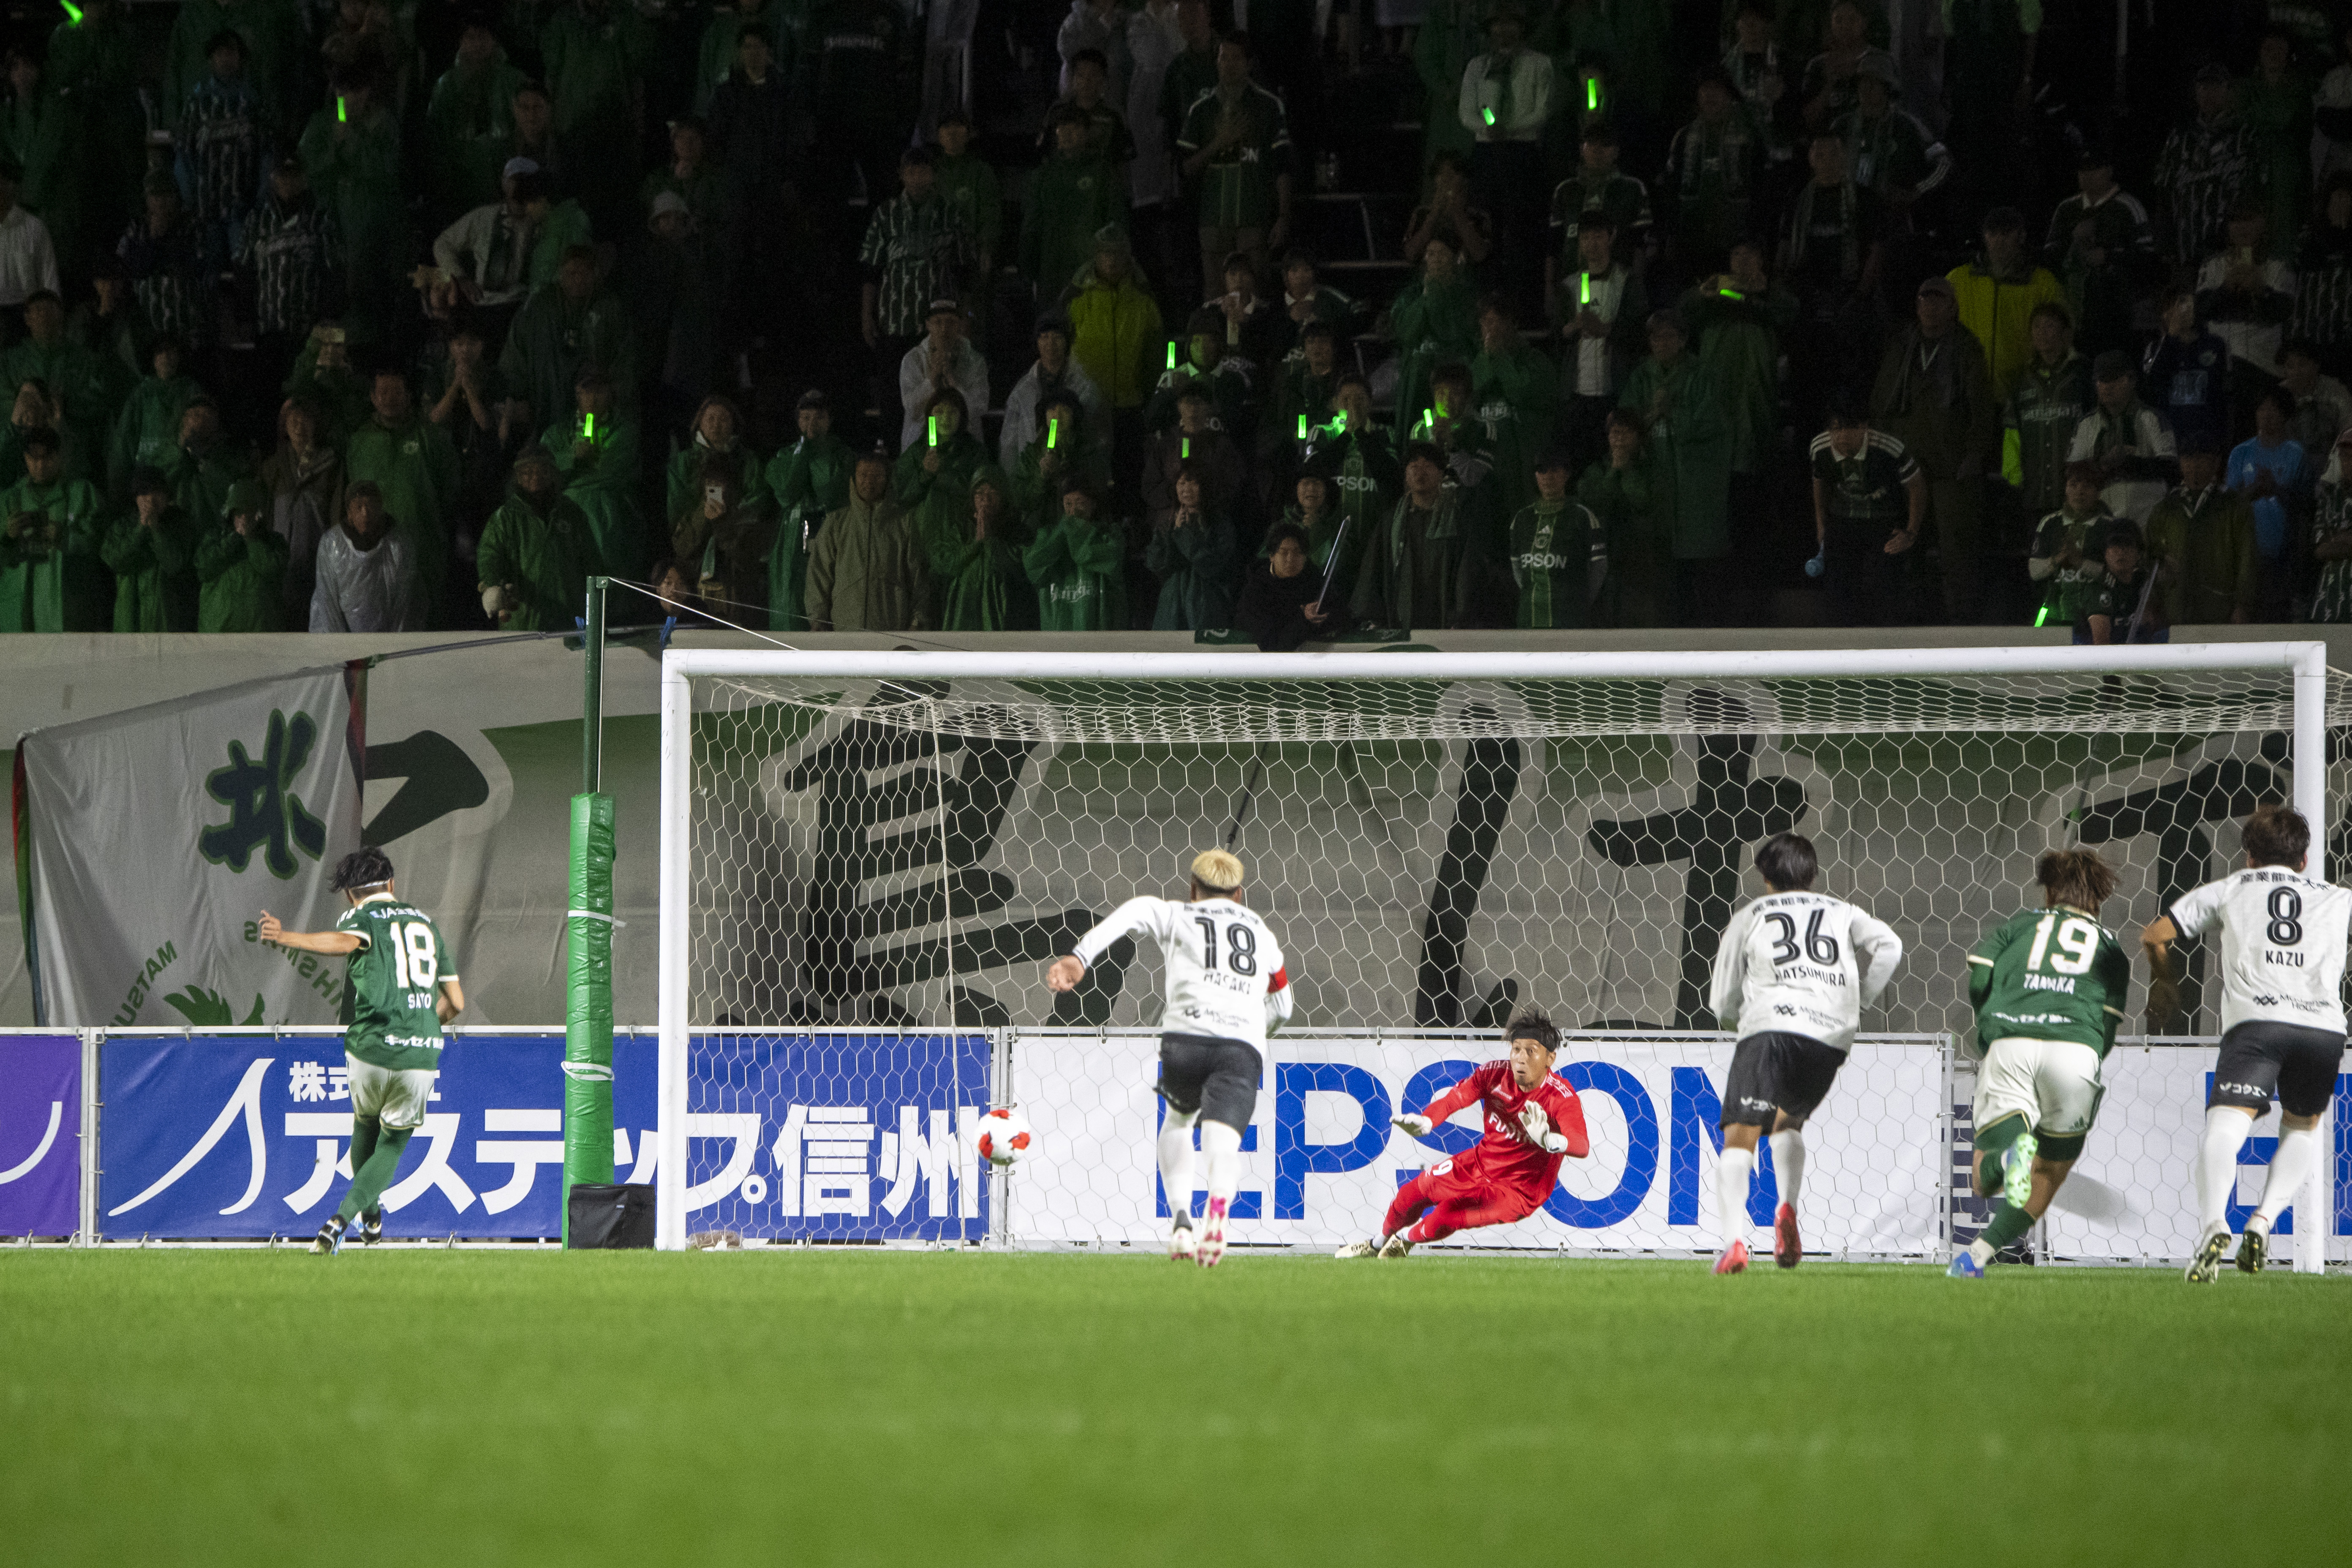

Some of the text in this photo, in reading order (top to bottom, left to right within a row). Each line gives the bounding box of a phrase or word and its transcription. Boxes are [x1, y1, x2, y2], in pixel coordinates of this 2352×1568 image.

[1764, 908, 1839, 966] 36
[2027, 914, 2099, 975] 19
[2267, 886, 2303, 946] 8
[390, 921, 437, 989] 18
[1195, 916, 1257, 977] 18
[2265, 950, 2304, 968] KAZU
[407, 993, 433, 1010] SATO
[2023, 973, 2075, 995] TANAKA
[289, 1061, 441, 1102] 株式
